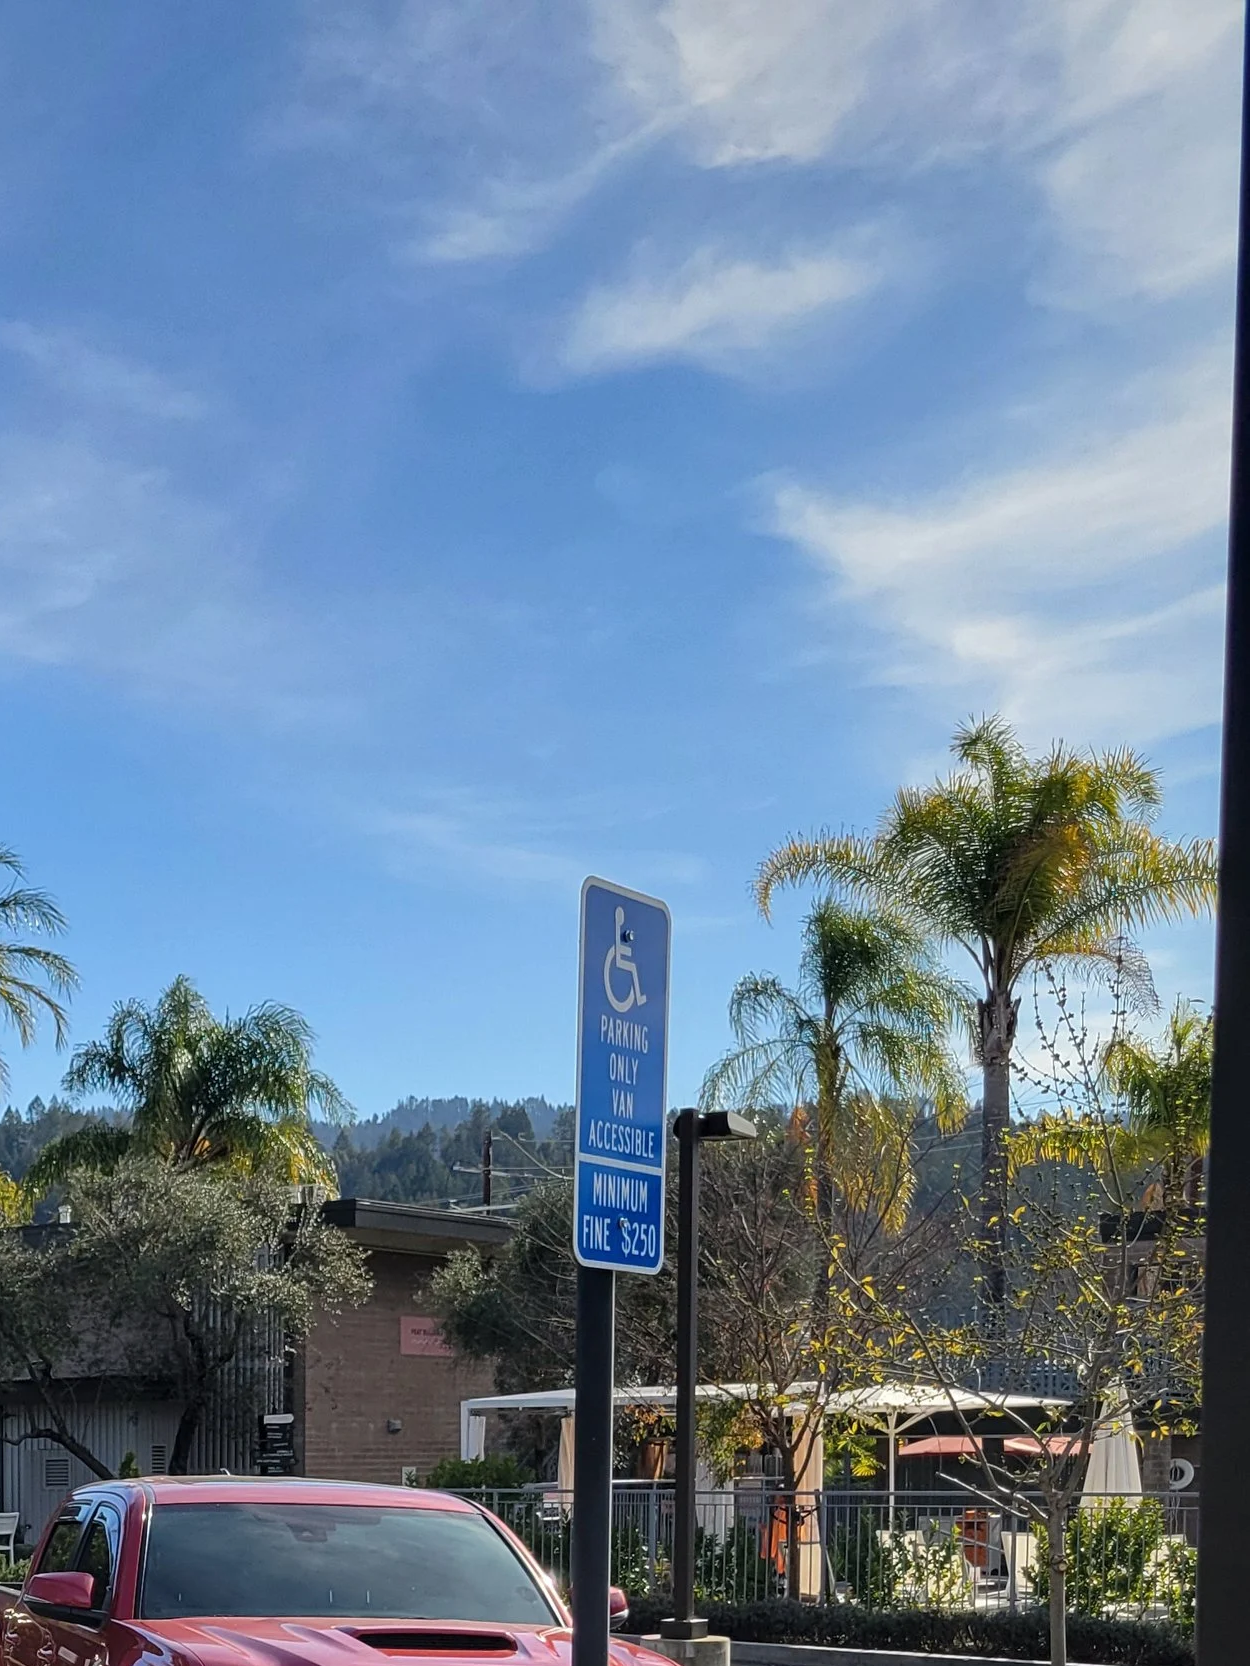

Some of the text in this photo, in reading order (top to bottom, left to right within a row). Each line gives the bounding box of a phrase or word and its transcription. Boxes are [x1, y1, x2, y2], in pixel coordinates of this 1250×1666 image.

[600, 1015, 649, 1053] PARKING
[609, 1053, 639, 1086] ONLY
[612, 1088, 634, 1120] VAN
[588, 1119, 655, 1159] ACCESSIBLE
[593, 1172, 648, 1214] MINIMUM
[583, 1215, 656, 1259] FINE $250
